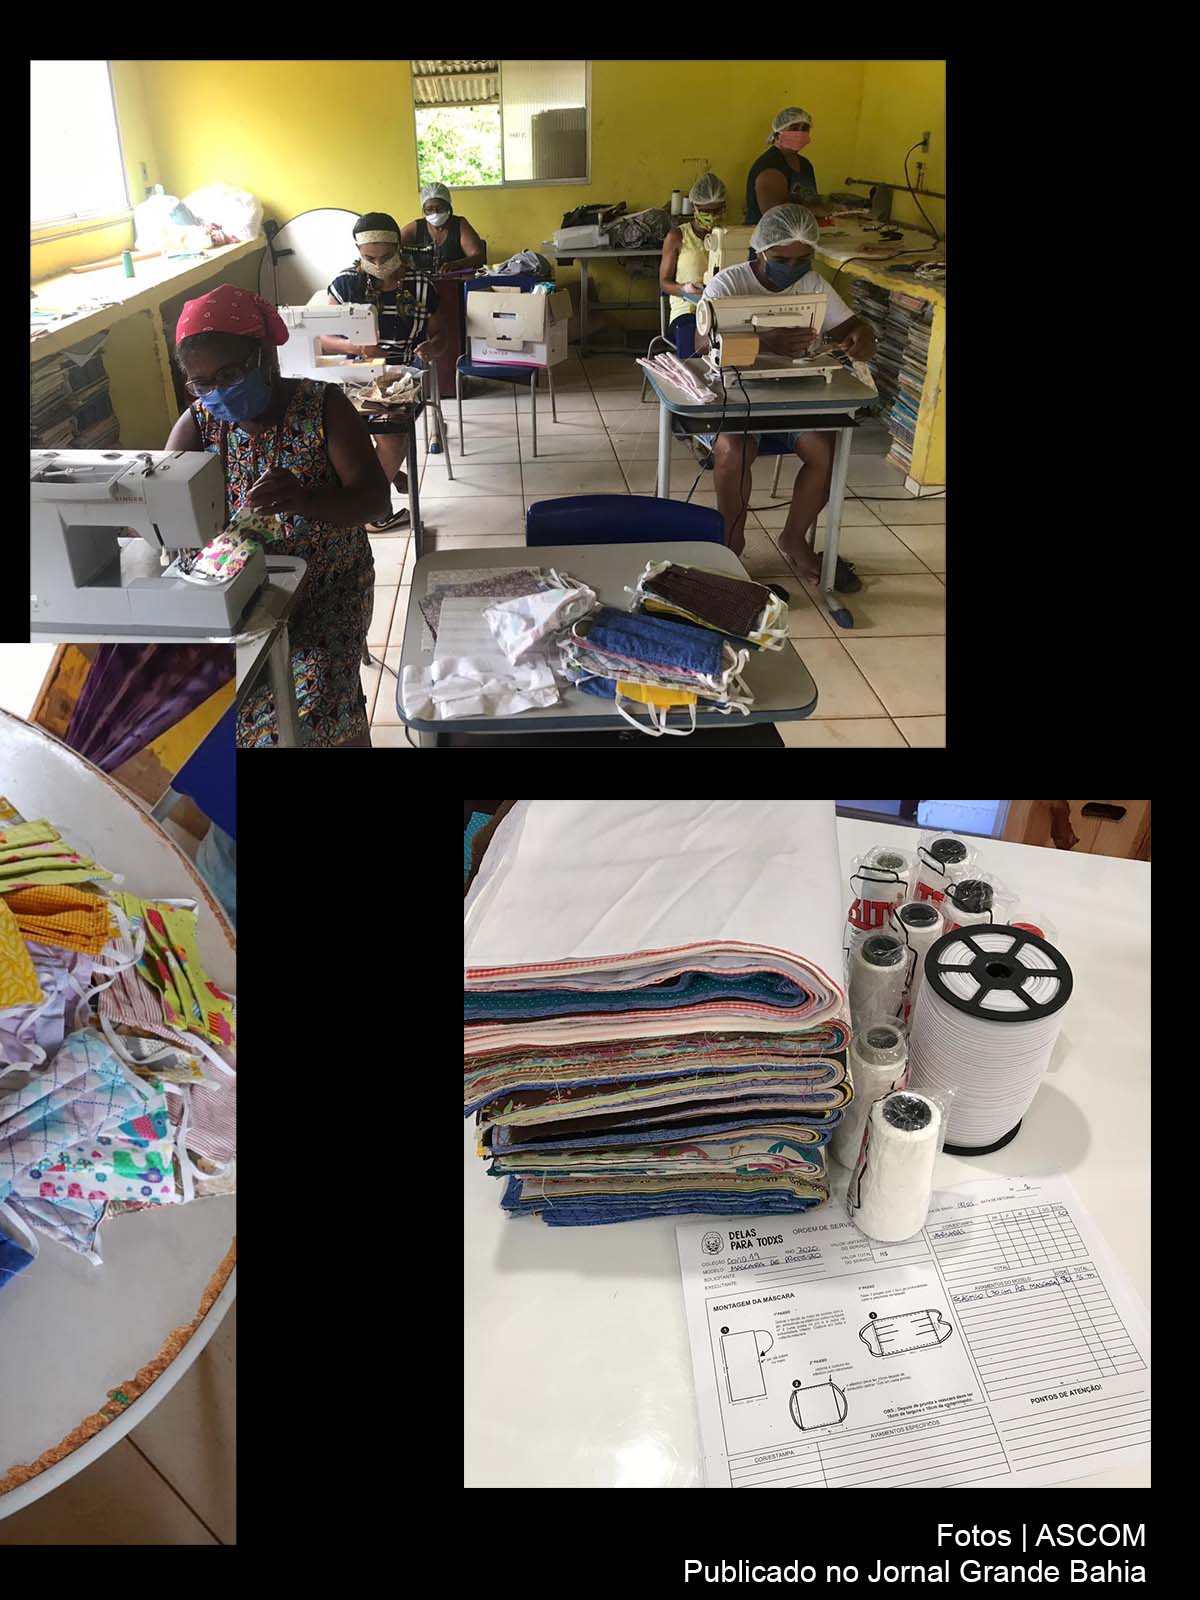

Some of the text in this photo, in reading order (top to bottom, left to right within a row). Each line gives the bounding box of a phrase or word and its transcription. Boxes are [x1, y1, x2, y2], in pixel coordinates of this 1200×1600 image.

[729, 1229, 757, 1240] DELAS
[792, 1221, 856, 1235] ORDEM DE SERVIÇ
[731, 1234, 784, 1251] PARA TODXS
[713, 1292, 795, 1312] MONTAGEM DA MÁSCARA
[1030, 1384, 1103, 1404] PONTOS DE ATENÇÃO!
[870, 1424, 905, 1439] AVIAMENTOS
